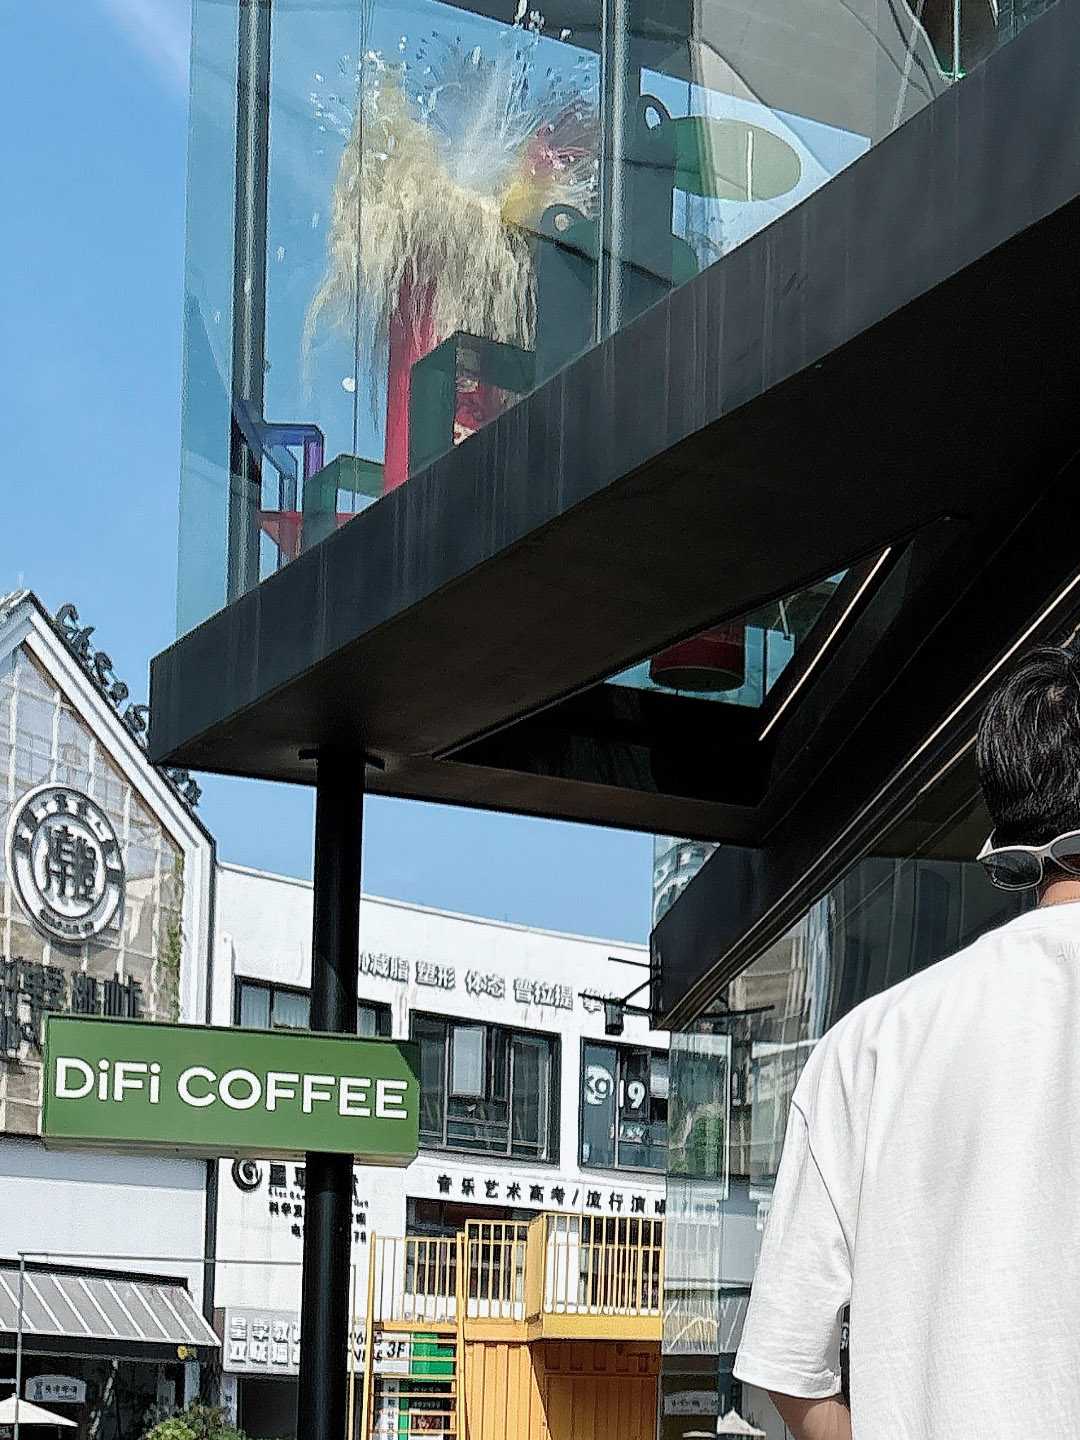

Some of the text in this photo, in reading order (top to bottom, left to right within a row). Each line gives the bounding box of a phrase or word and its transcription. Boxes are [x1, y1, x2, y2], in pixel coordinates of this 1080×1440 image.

[55, 1056, 408, 1120] DiFi COFFEE
[386, 1341, 407, 1359] 3F
